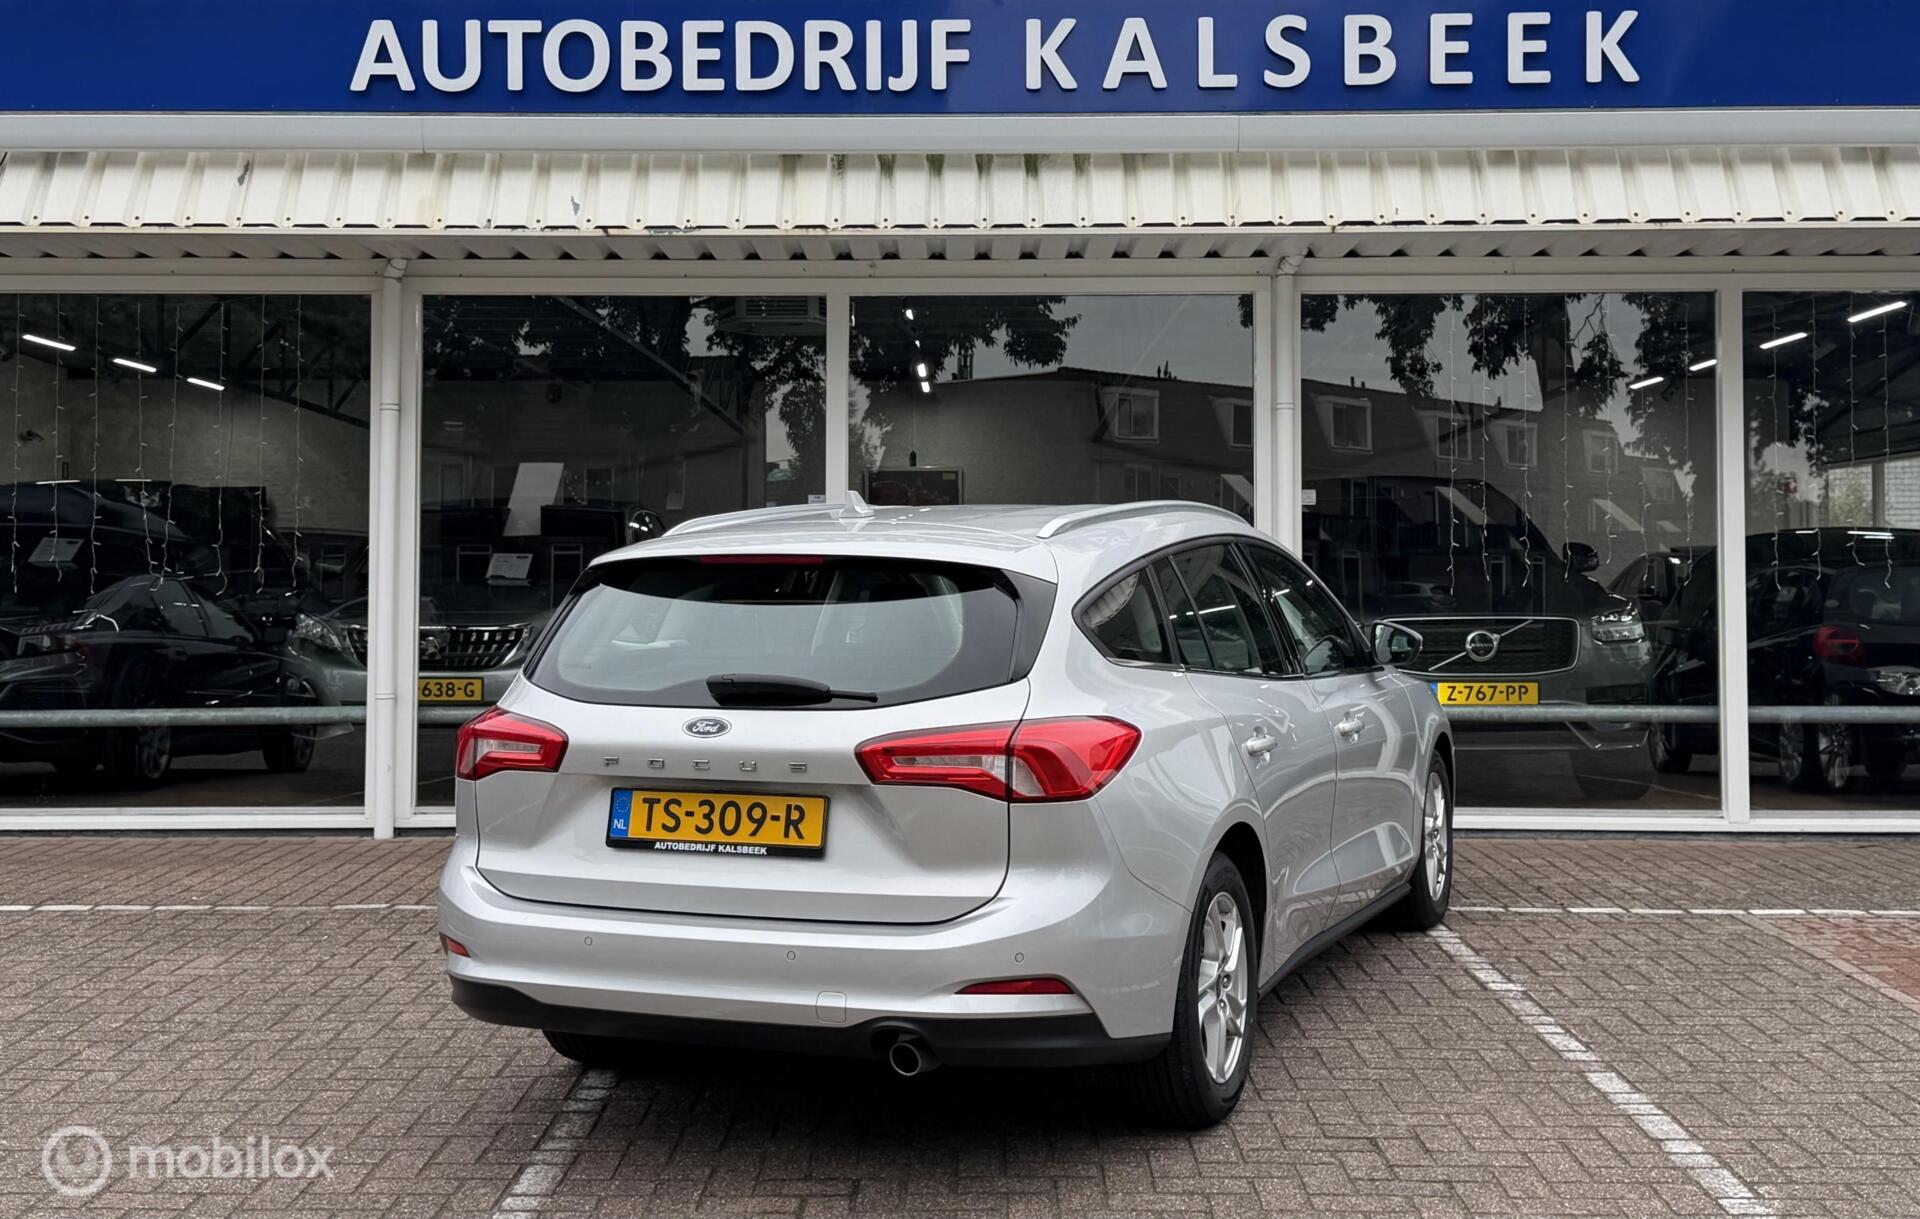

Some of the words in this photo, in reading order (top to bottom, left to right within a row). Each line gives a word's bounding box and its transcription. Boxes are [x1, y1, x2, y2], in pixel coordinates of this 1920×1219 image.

[350, 18, 972, 93] AUTOBEDRIJF
[1024, 10, 1640, 91] KALSBEEK
[1446, 685, 1529, 702] Z-767-PP
[692, 721, 720, 733] Ford
[603, 756, 808, 773] FOCUS
[613, 818, 627, 830] NL
[641, 797, 806, 840] TS-309-R
[654, 840, 716, 854] AUTOBEDRIJF
[718, 845, 768, 856] KALSBEEK
